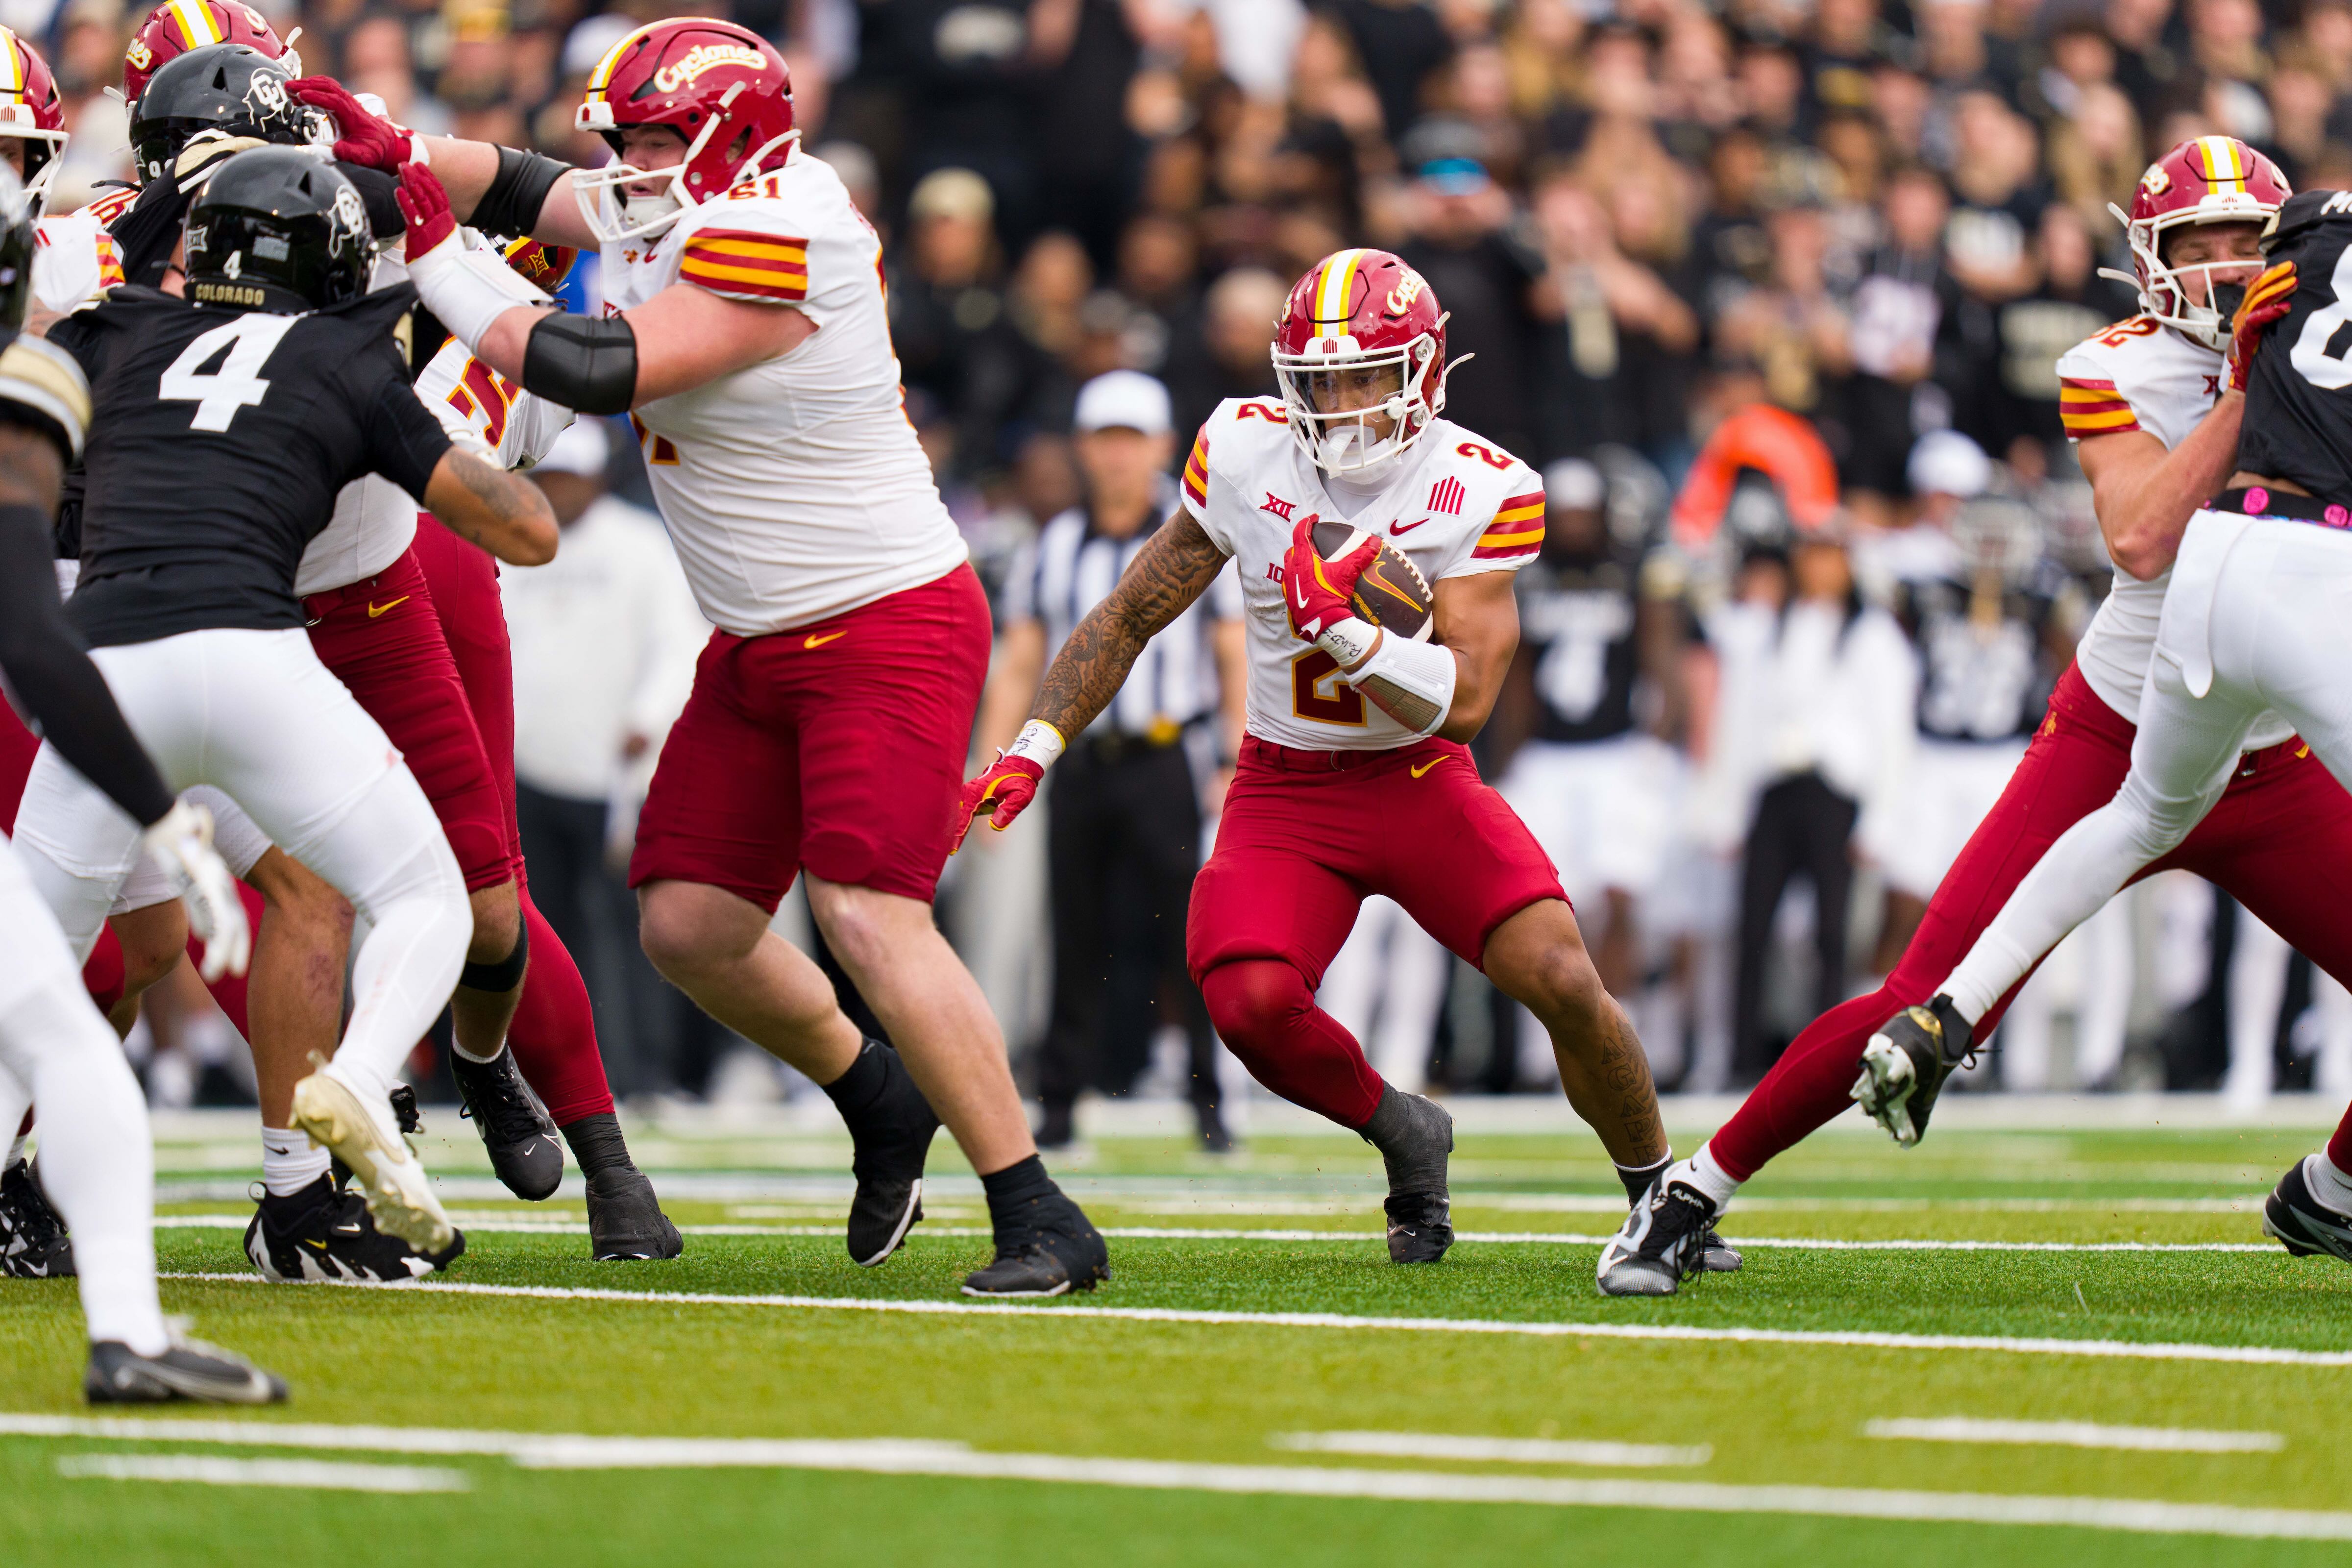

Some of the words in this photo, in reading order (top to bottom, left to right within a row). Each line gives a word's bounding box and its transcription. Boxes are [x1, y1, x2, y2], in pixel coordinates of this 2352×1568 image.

[654, 44, 767, 93] Cyclones
[148, 158, 174, 179] 9
[2320, 190, 2352, 216] M
[222, 250, 242, 280] 4
[196, 283, 265, 307] COLORADO
[158, 312, 300, 433] 4
[1236, 403, 1290, 425] 2
[1456, 442, 1516, 471] 2
[1259, 490, 1297, 523] XII
[1266, 562, 1285, 585] IO
[1290, 627, 1368, 728] 2
[1601, 1035, 1662, 1167] AGAPE
[1670, 1188, 1705, 1210] ALPHA
